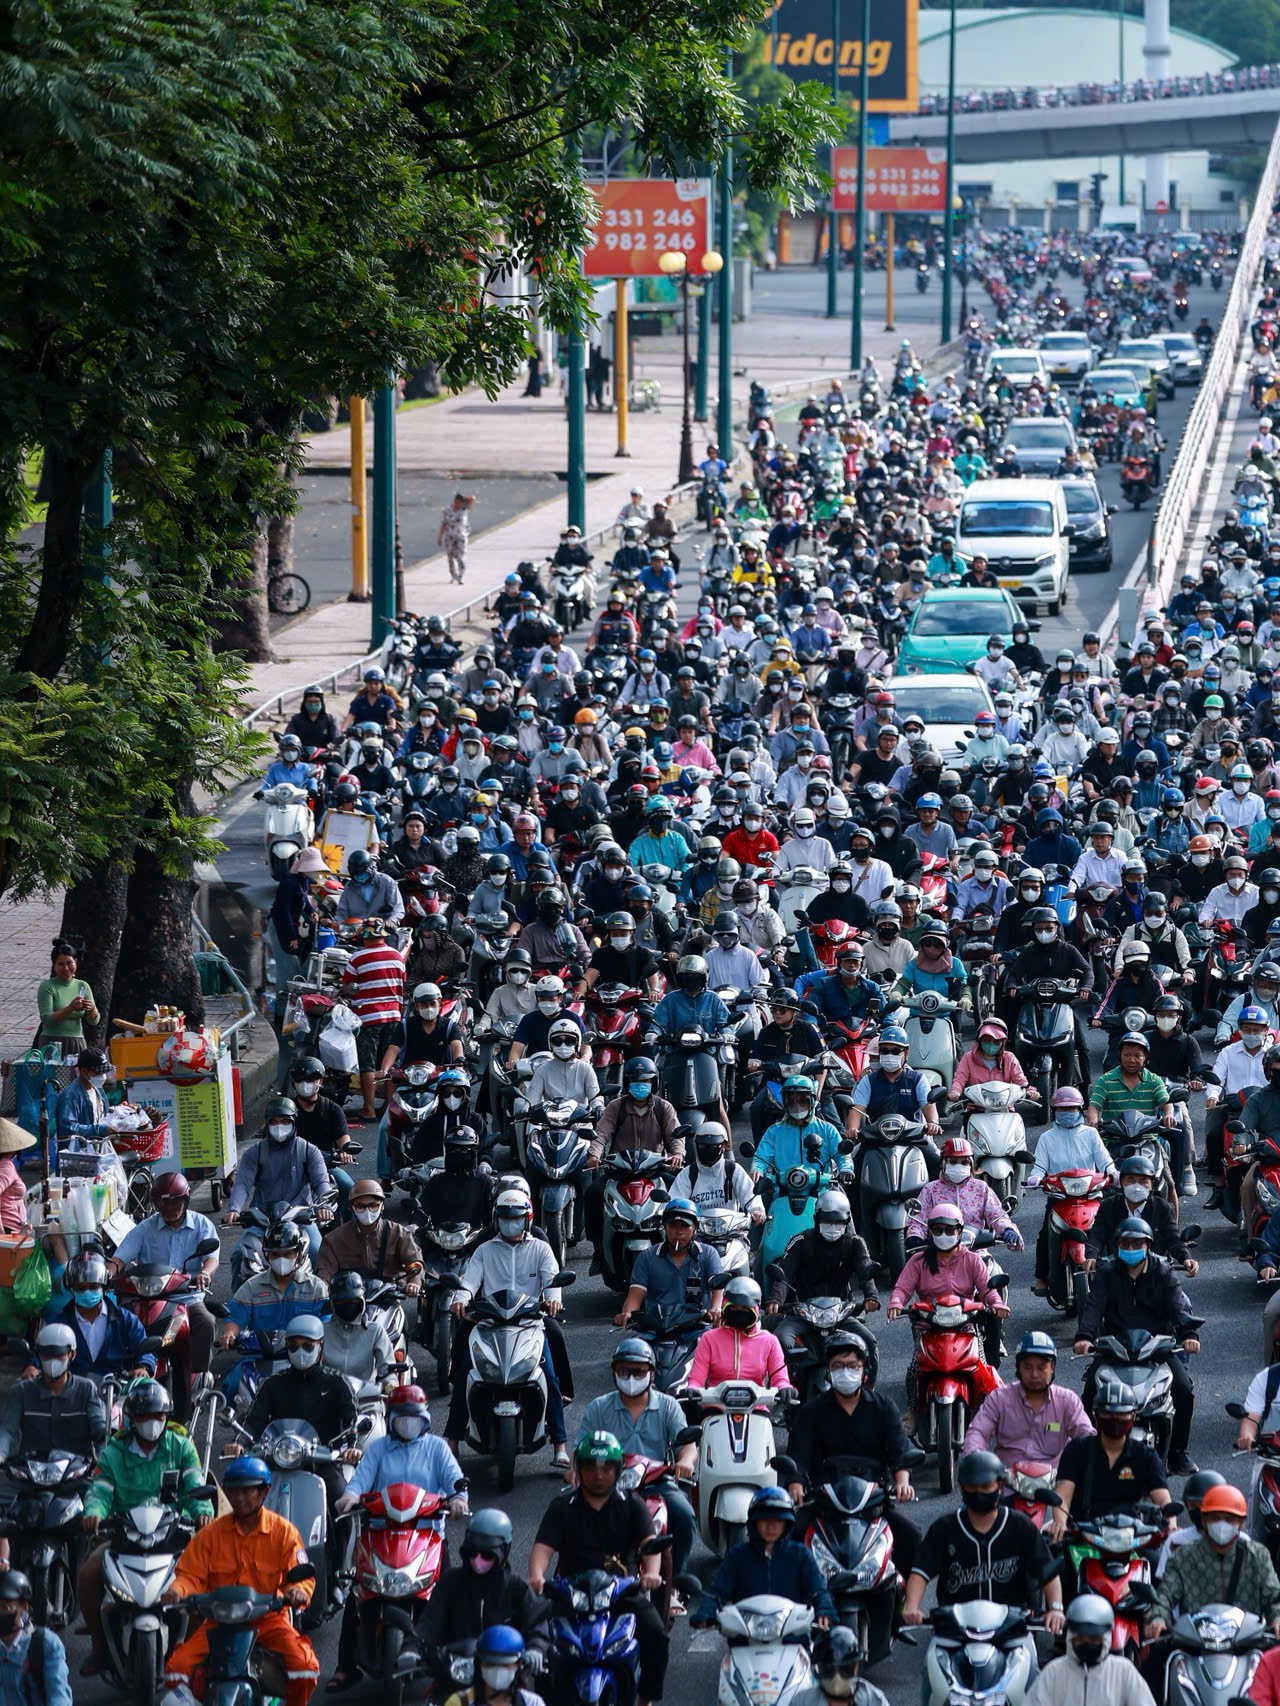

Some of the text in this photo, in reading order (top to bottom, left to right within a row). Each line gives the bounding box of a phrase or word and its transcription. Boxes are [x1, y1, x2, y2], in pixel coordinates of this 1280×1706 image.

[838, 167, 876, 179] 096
[838, 182, 877, 195] 099
[604, 209, 695, 227] 331 246
[604, 232, 647, 251] 982
[654, 232, 696, 250] 246
